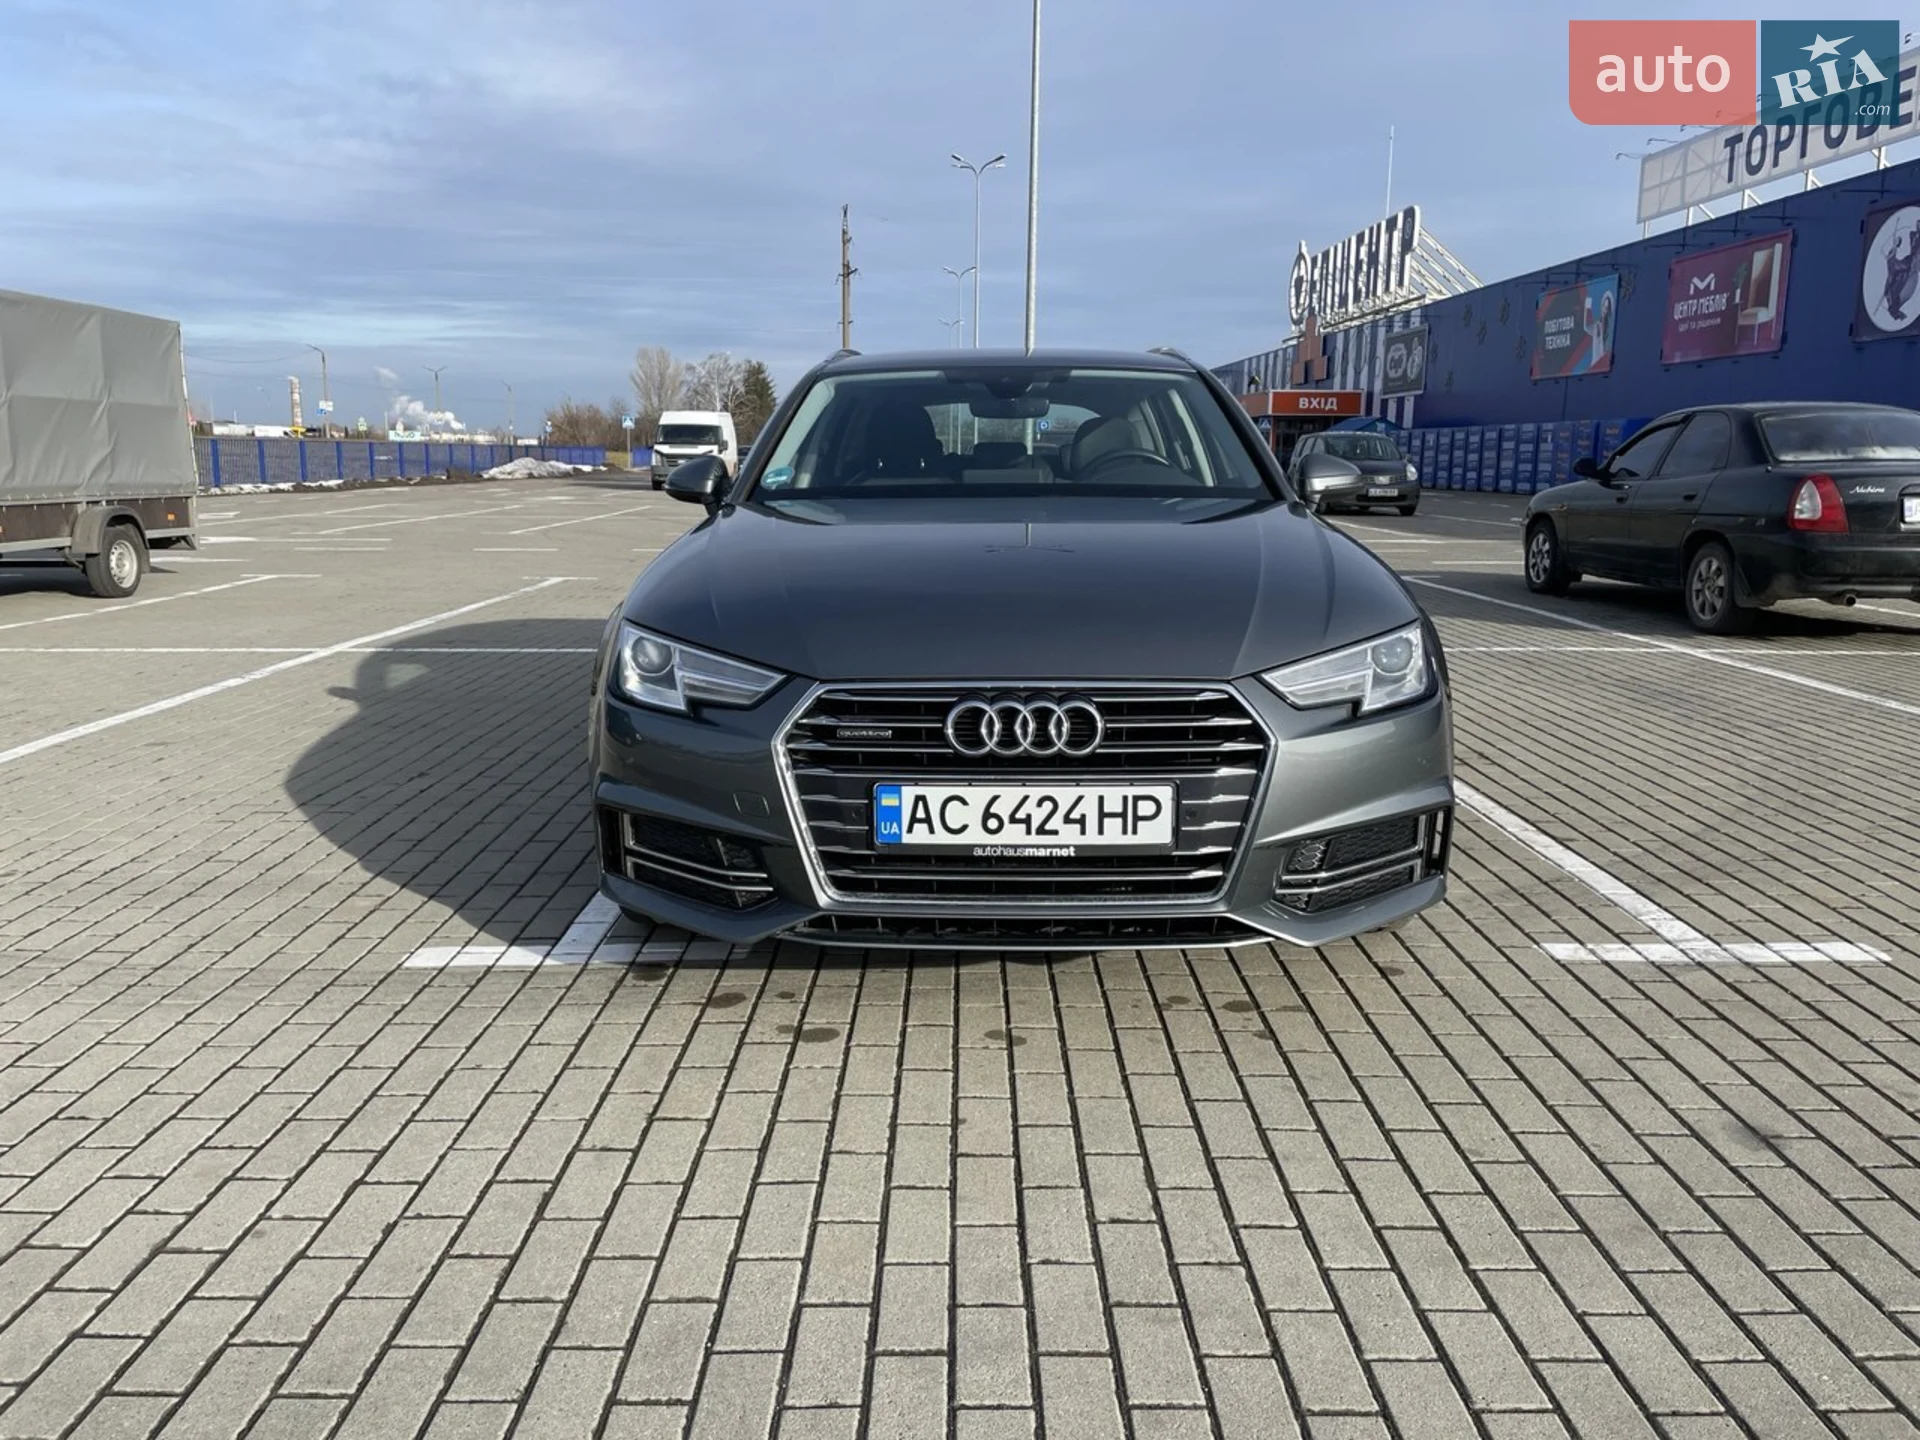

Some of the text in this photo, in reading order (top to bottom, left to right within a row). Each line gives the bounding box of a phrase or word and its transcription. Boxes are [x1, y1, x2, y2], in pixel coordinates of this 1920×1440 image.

[1724, 65, 1920, 184] ТОРГОВЕ
[1299, 397, 1338, 411] ВХІД
[906, 794, 970, 835] AC
[981, 794, 1087, 835] 6424
[881, 822, 900, 834] UA
[973, 845, 1076, 857] autohausmarnet
